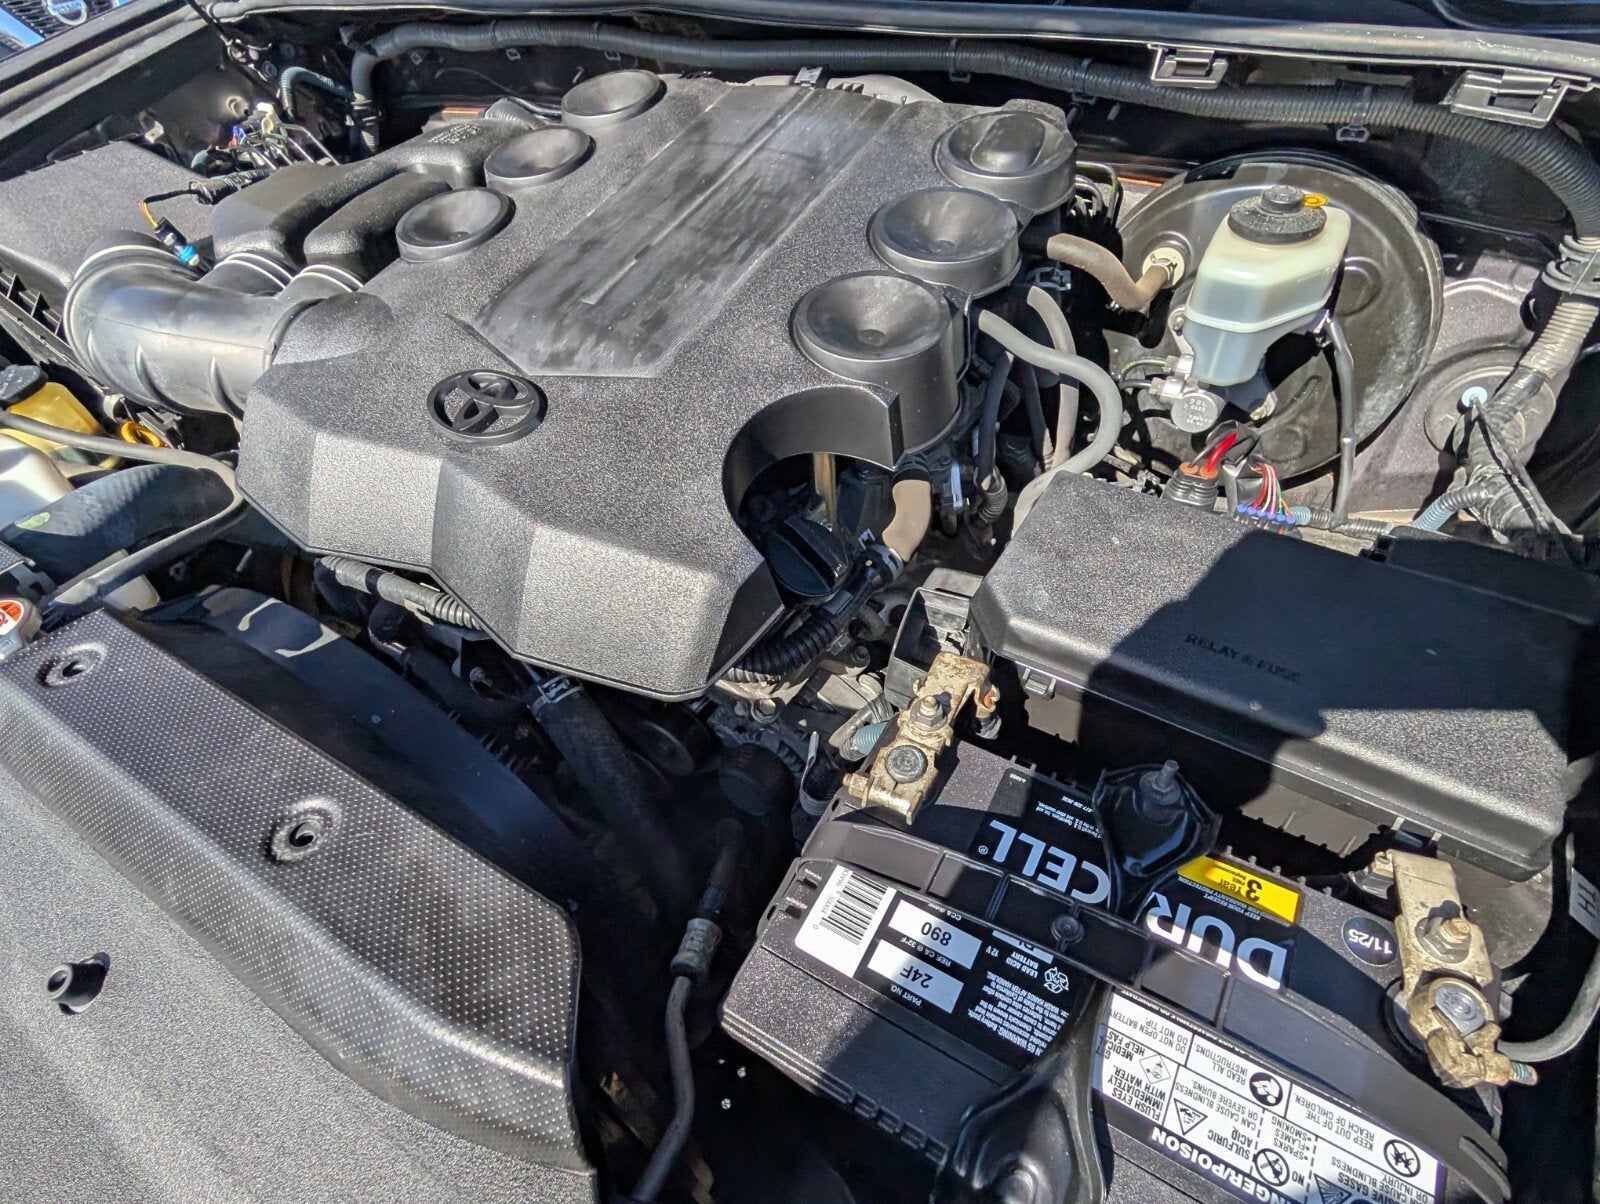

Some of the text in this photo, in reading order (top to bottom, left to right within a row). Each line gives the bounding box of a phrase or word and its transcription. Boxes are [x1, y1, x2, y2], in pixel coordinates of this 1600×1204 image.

[1218, 877, 1265, 903] 3 Year
[1227, 902, 1244, 914] YOUR
[1246, 905, 1259, 914] FOR
[919, 919, 952, 948] 890
[1345, 927, 1393, 955] 11/25
[923, 947, 935, 958] CA
[935, 953, 951, 966] REF.
[1010, 950, 1039, 969] BATTERY
[899, 961, 933, 990] 24F
[1004, 956, 1038, 978] LEAD ACID
[889, 984, 921, 1005] PART NO.
[1140, 1023, 1158, 1040] OPEN
[1144, 1016, 1188, 1046] DO NOT TIP.
[1158, 1033, 1173, 1048] NOT
[1025, 1042, 1036, 1052] 65
[1124, 1038, 1145, 1057] HELP
[1176, 1042, 1185, 1055] DO
[1193, 1039, 1247, 1079] INSTRUCTIONS.
[1112, 1063, 1165, 1101] WITH WATER.
[1211, 1060, 1245, 1086] READ ALL
[1106, 1071, 1163, 1112] IMMEDIATELY
[1111, 1086, 1160, 1121] FLUSH EYES
[1174, 1080, 1256, 1131] CAN CAUSE BLINDNESS
[1190, 1078, 1258, 1122] OR SEVERE BURNS.
[1292, 1090, 1374, 1142] REACH OF CHILDREN.
[1305, 1108, 1373, 1152] KEEP OUT OF THE
[1206, 1127, 1250, 1161] SULFURIC
[1150, 1124, 1291, 1204] NGER/POISON
[1291, 1169, 1304, 1186] NO
[1330, 1154, 1407, 1204] CAUSE BLINDNESS
[1336, 1169, 1369, 1197] GASES
[1379, 1170, 1428, 1204] OR INJURY.
